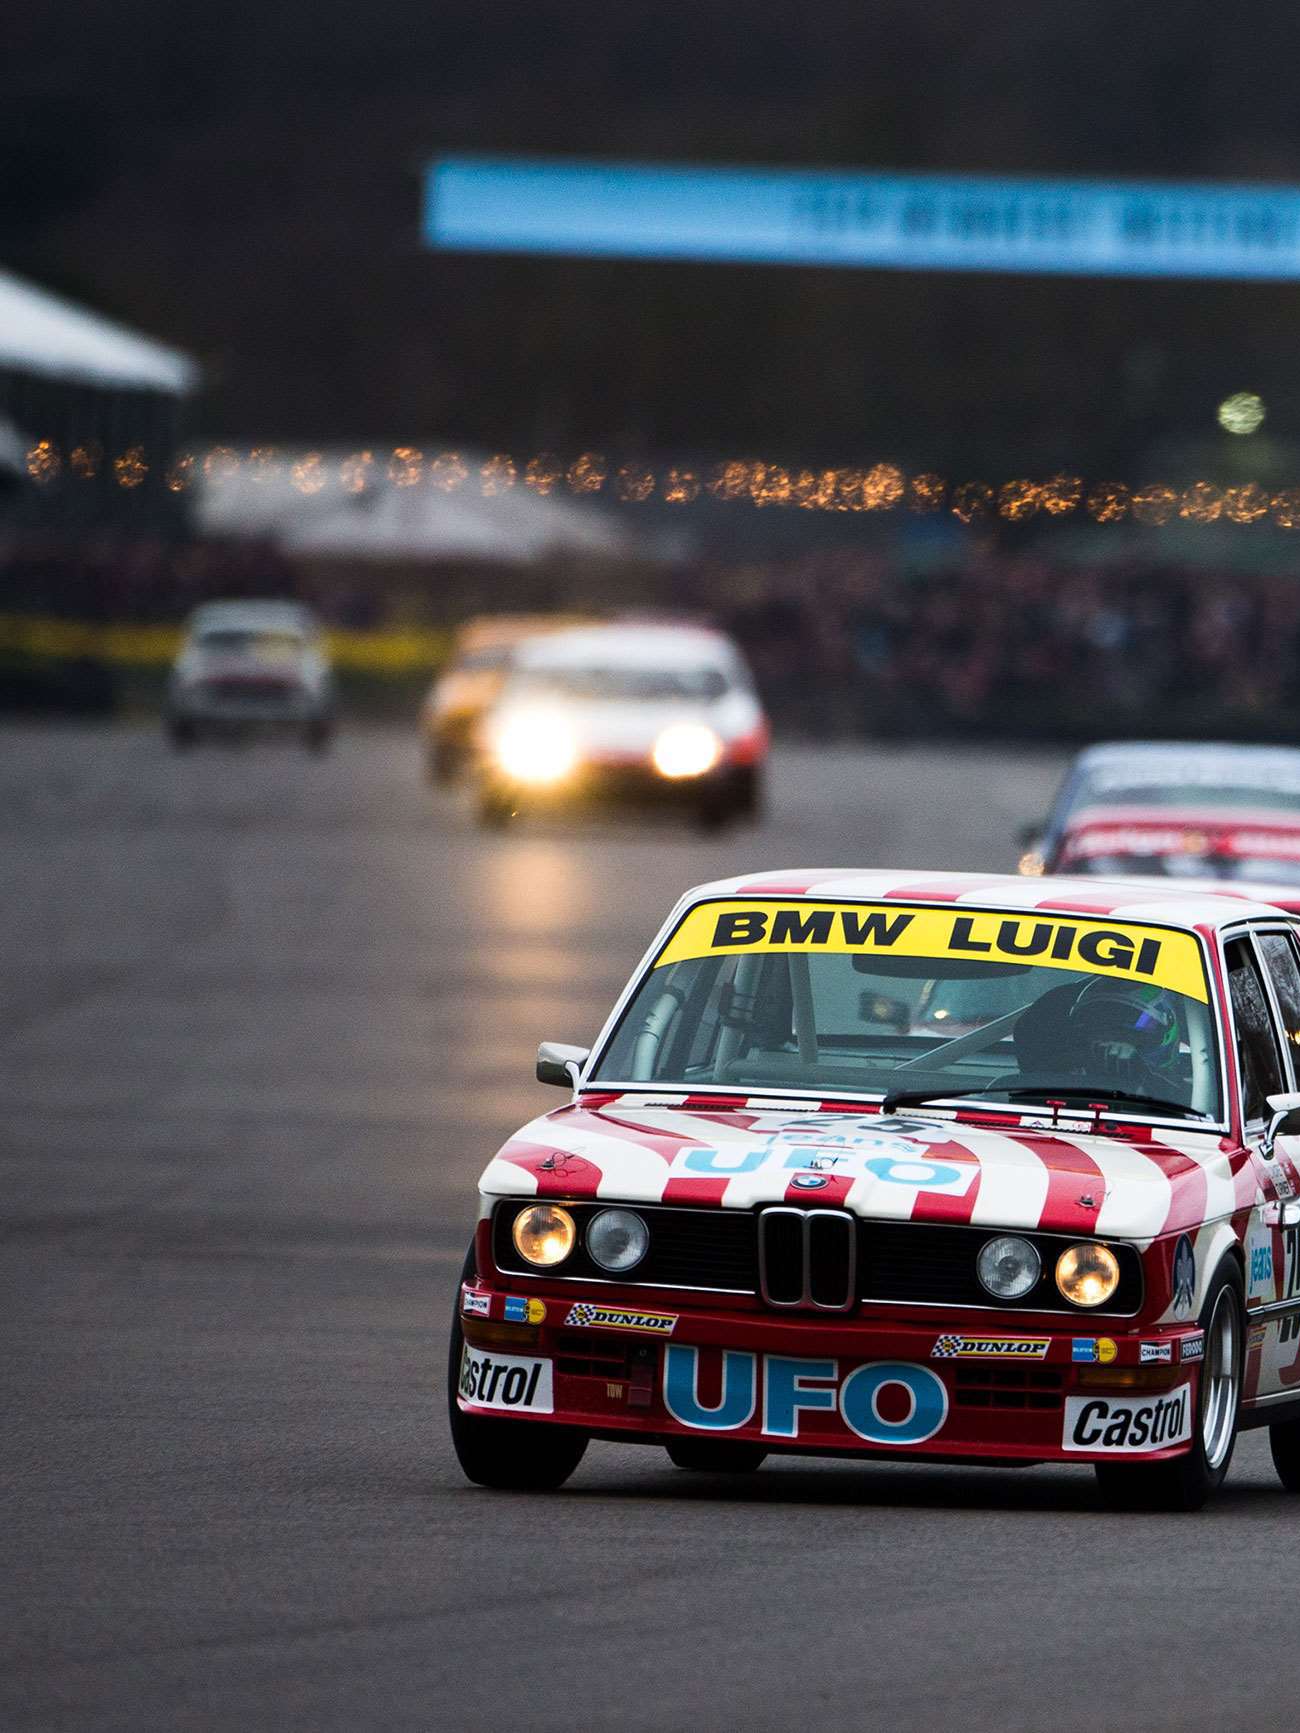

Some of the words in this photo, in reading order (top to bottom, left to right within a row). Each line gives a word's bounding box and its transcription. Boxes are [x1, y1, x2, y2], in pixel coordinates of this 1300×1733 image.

[711, 911, 915, 948] BMW
[948, 917, 1162, 976] LUIGI
[684, 1148, 961, 1186] UFO
[592, 1310, 674, 1331] DUNLOP
[961, 1340, 1047, 1354] DUNLOP
[1140, 1348, 1172, 1358] CHAMPION
[606, 1383, 623, 1399] TOW
[662, 1343, 949, 1445] UFO
[1072, 1389, 1189, 1447] Castrol
